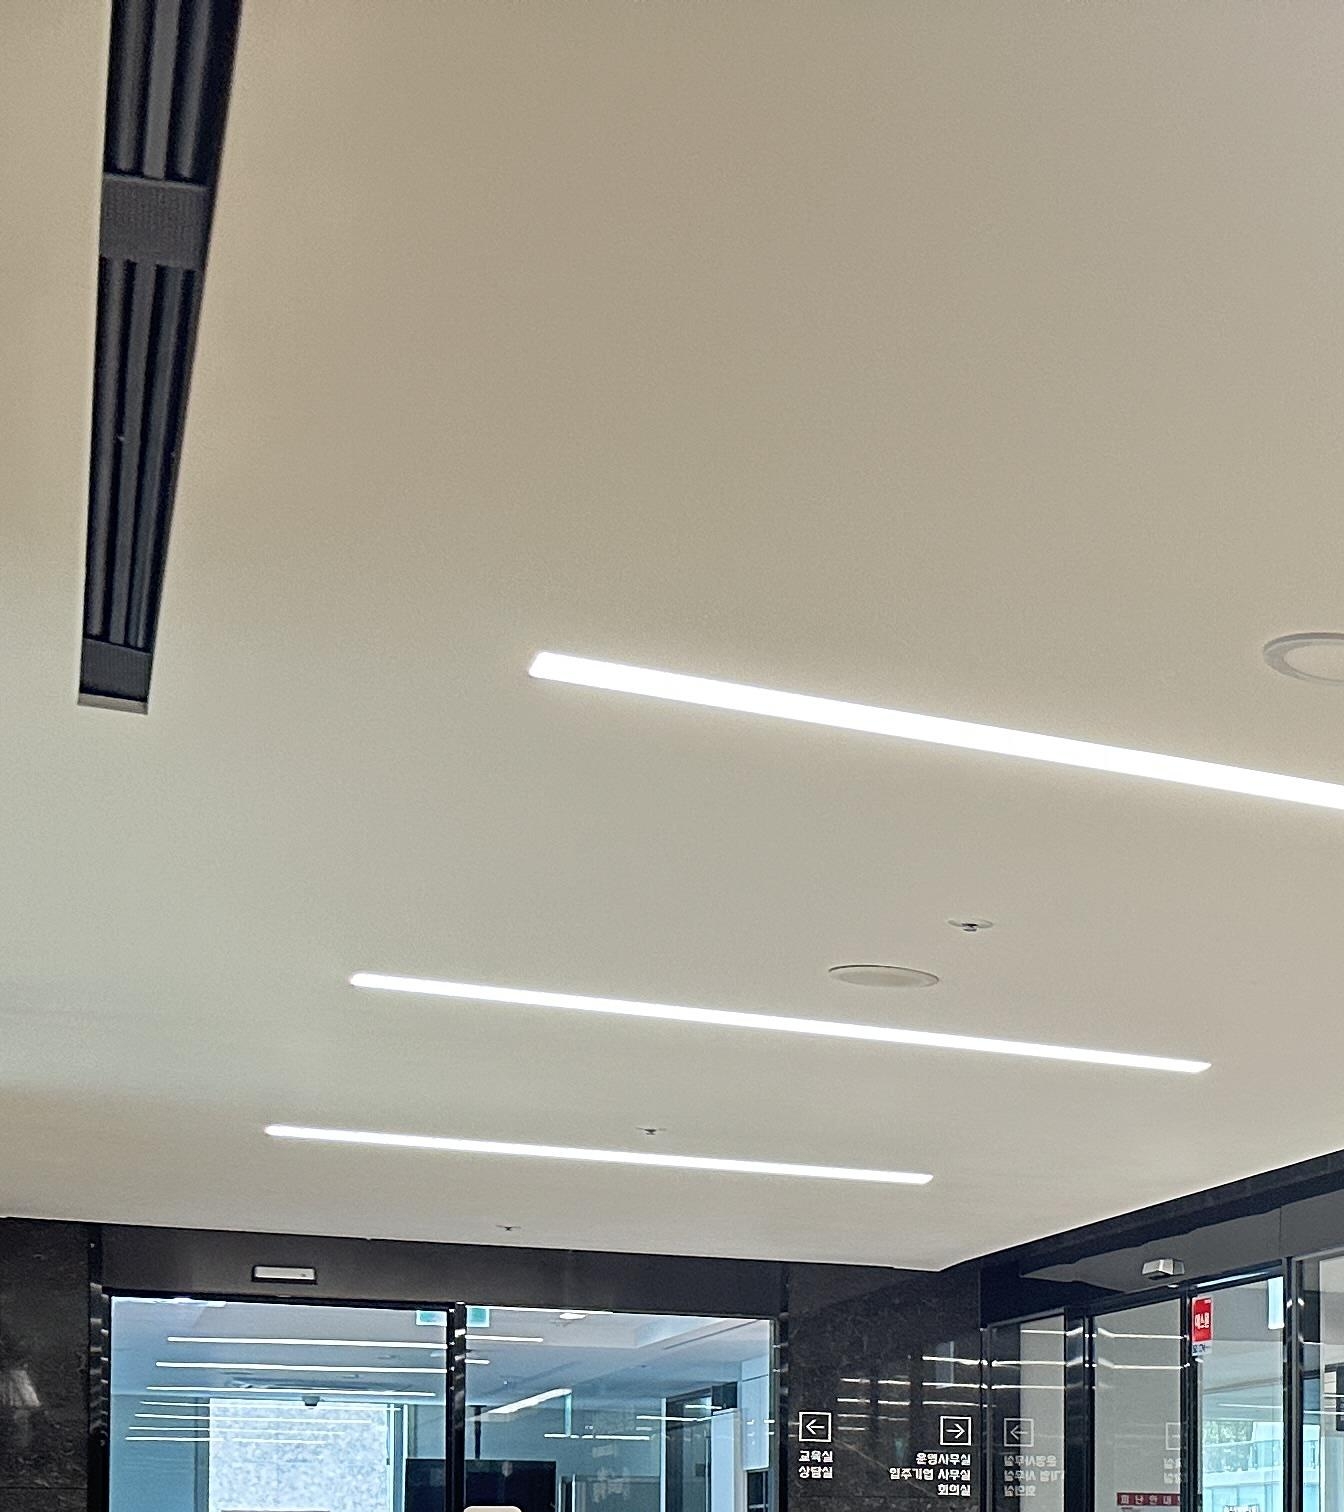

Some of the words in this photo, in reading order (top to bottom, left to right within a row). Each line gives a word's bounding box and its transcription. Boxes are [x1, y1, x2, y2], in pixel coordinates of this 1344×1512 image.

[799, 1450, 833, 1463] 교육실
[916, 1453, 971, 1466] 운영사무실
[799, 1466, 833, 1479] 상담실
[937, 1468, 971, 1481] 사무실
[937, 1484, 971, 1497] 회의실
[1120, 1494, 1180, 1505] 피난안내
